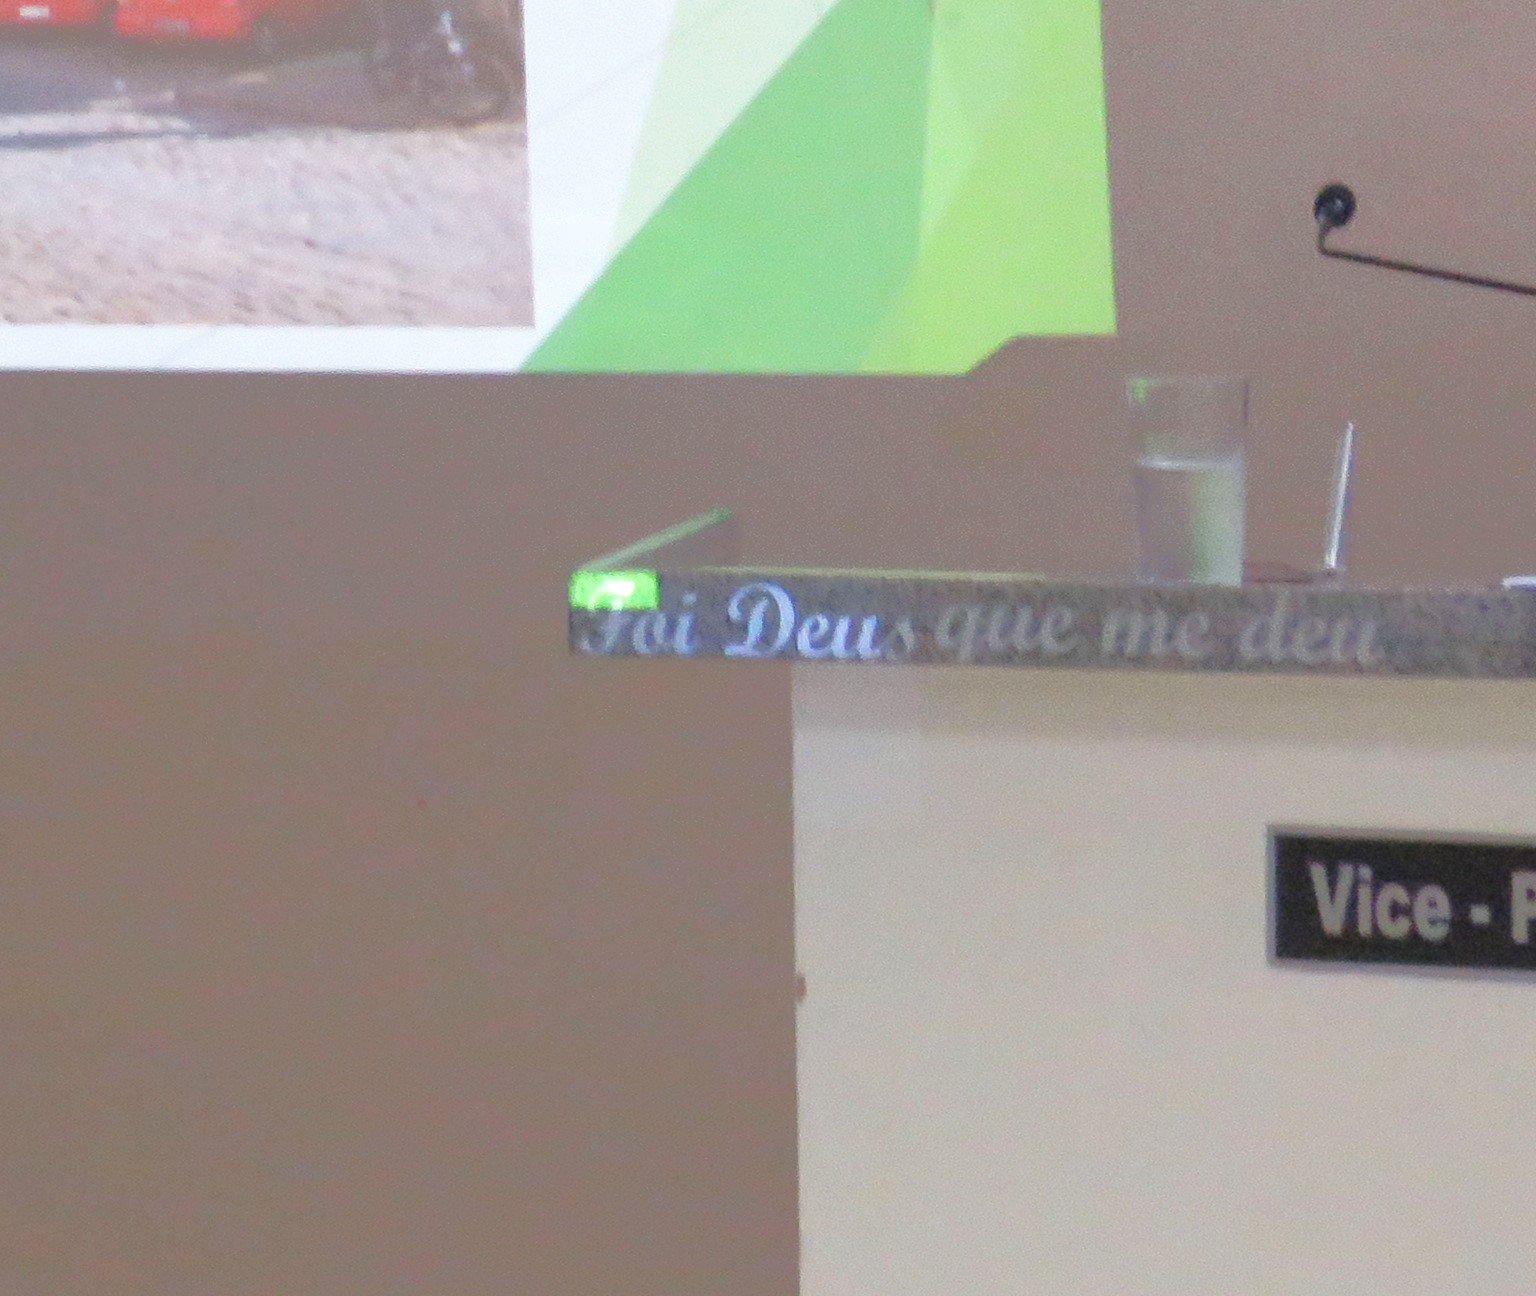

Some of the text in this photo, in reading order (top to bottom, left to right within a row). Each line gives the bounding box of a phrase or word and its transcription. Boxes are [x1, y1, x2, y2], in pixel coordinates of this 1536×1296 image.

[724, 580, 916, 661] Deus
[933, 600, 1079, 664] que
[1101, 606, 1213, 659] me
[1238, 589, 1385, 666] deu
[1307, 860, 1452, 942] Vice
